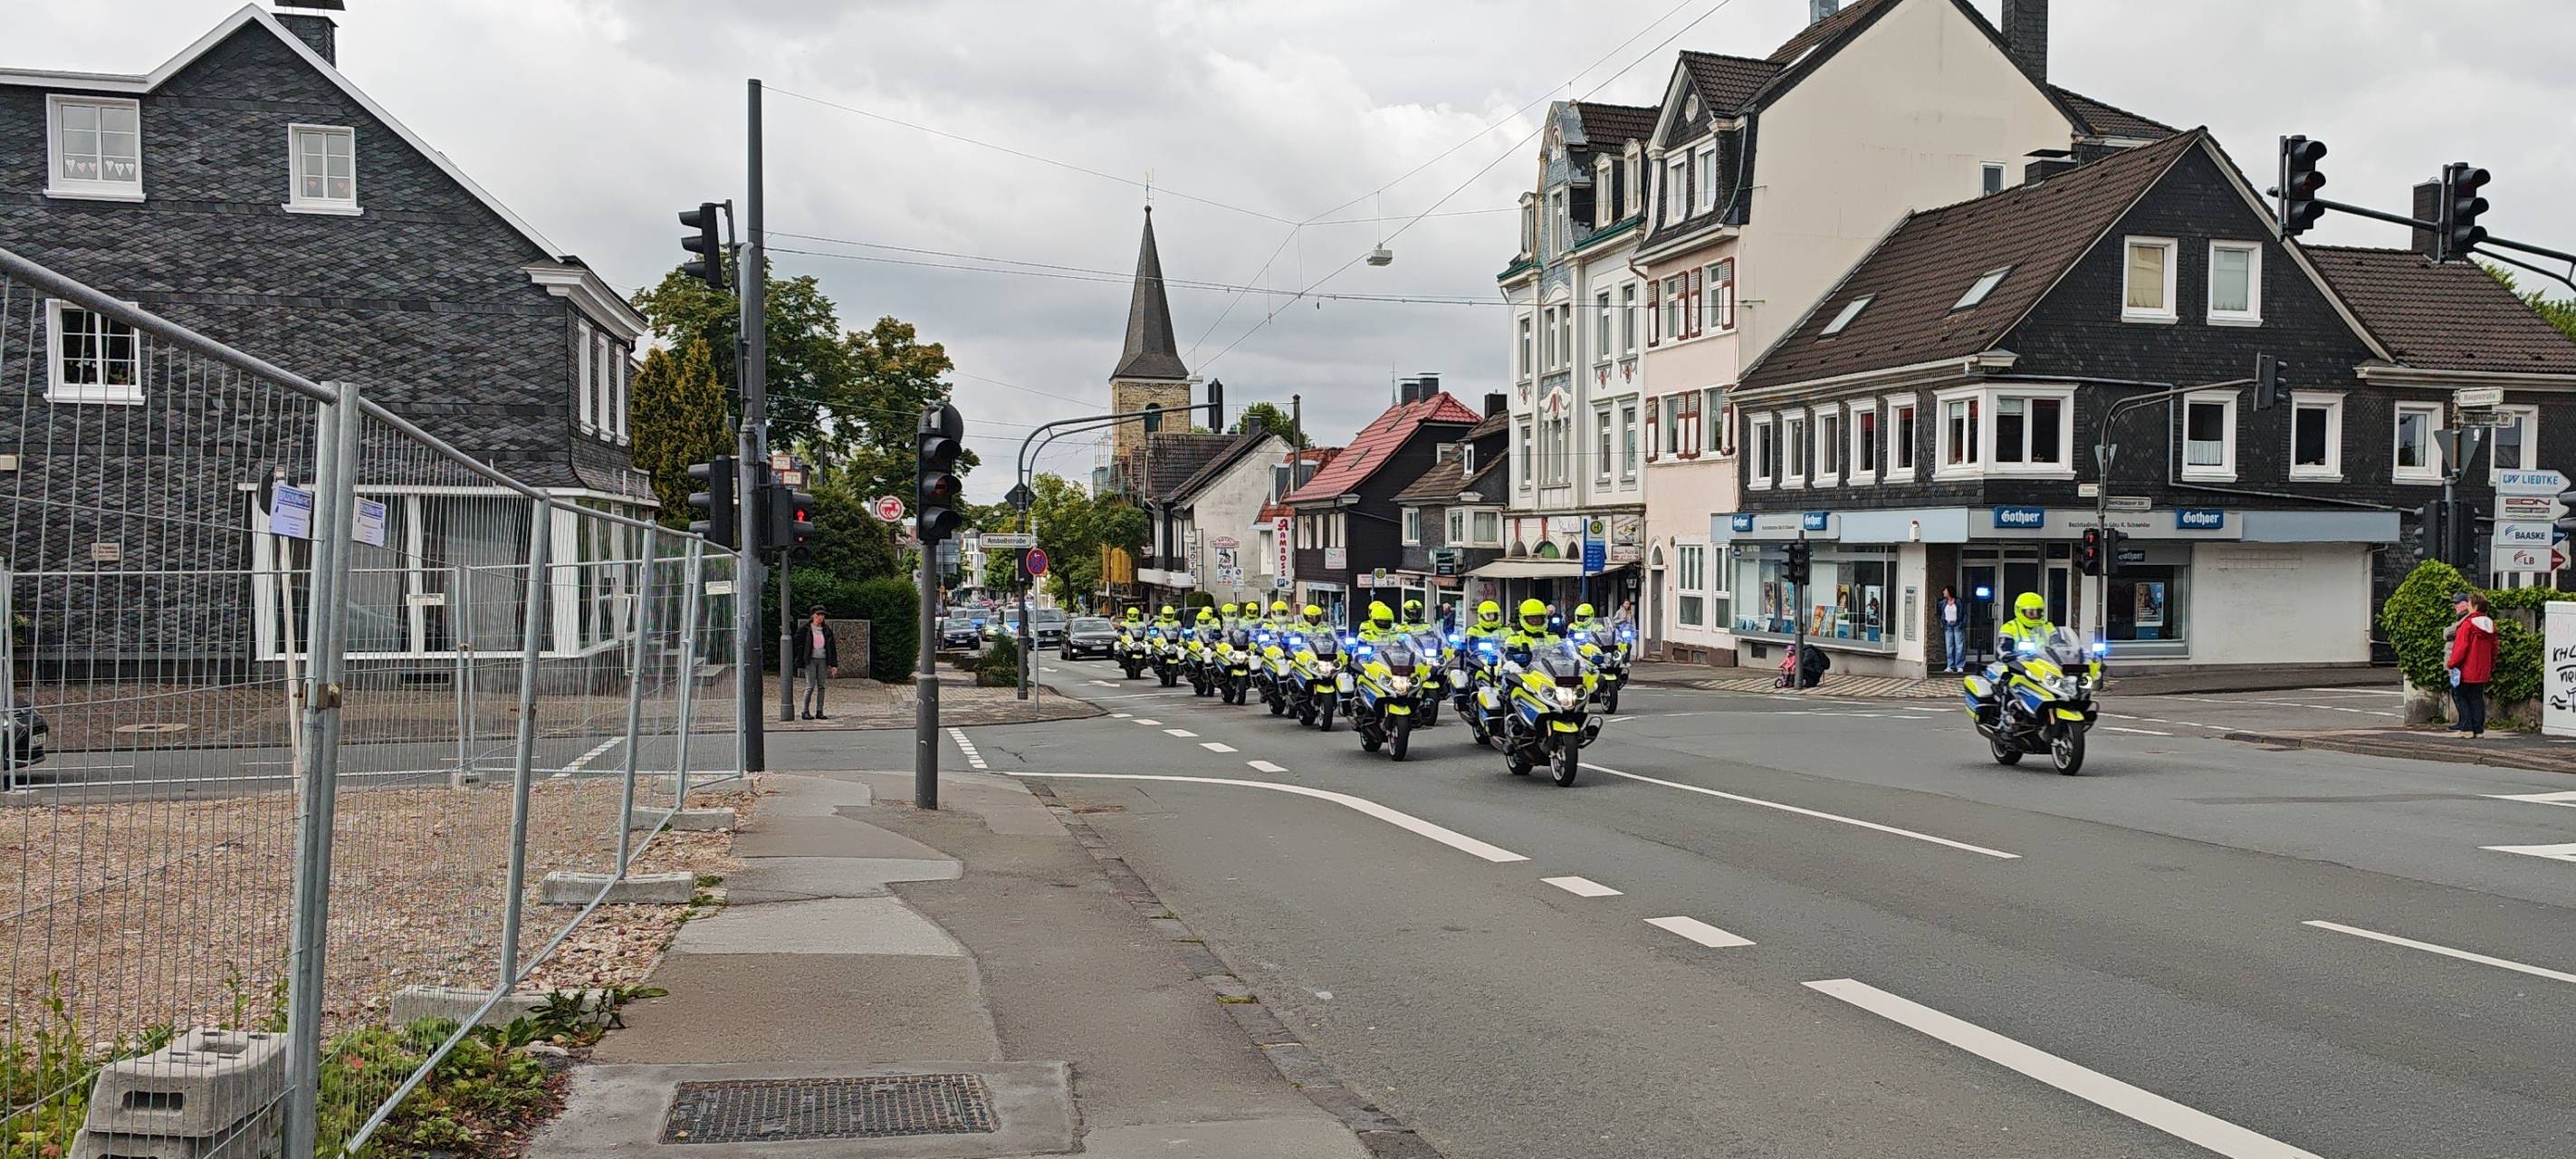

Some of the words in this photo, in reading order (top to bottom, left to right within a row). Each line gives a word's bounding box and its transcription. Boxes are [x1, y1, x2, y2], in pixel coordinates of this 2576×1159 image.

[2522, 474, 2560, 485] LIEDTKE
[2000, 509, 2041, 524] Gothaer
[2182, 510, 2220, 526] Gothaer
[2514, 531, 2546, 541] BAASKE
[2523, 556, 2535, 566] LB
